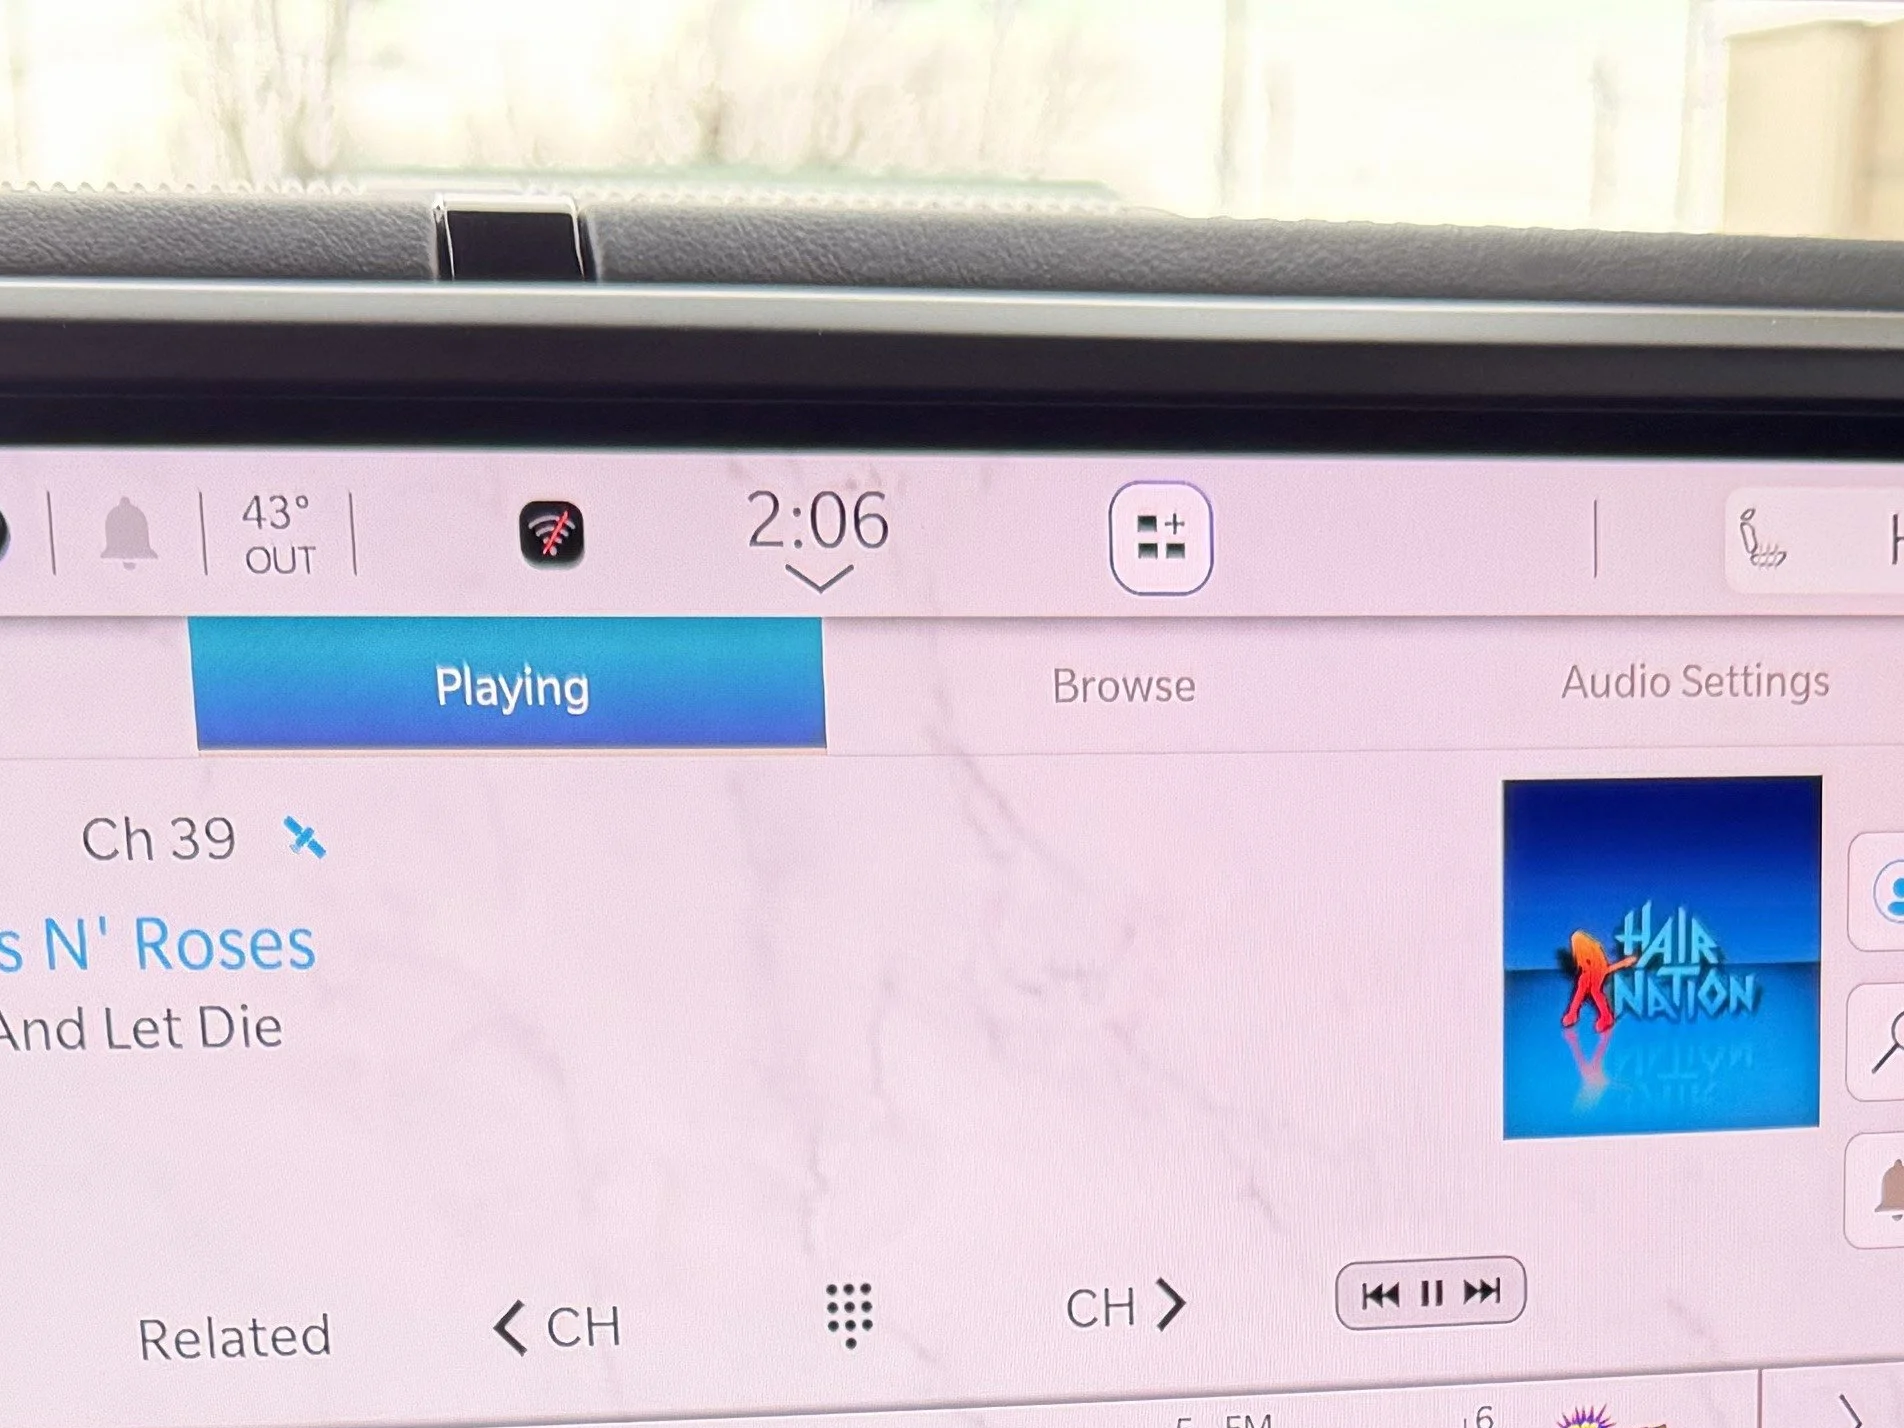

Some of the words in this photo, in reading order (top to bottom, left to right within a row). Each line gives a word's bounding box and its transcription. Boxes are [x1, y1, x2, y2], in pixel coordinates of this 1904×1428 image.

[241, 494, 310, 530] 43°
[747, 489, 889, 549] 2:06
[245, 545, 316, 576] OUT
[435, 664, 591, 715] Playing
[1053, 666, 1197, 705] Browse
[1562, 662, 1671, 702] Audio
[1681, 662, 1830, 706] Settings
[82, 817, 154, 862] Ch
[170, 817, 236, 862] 39
[44, 914, 109, 973] N'
[136, 914, 317, 972] Roses
[1613, 900, 1724, 969] HAIR
[1612, 966, 1763, 1023] NATION
[104, 1006, 183, 1051] Let
[198, 1004, 284, 1049] Die
[546, 1305, 621, 1348] CH
[1066, 1288, 1135, 1329] CH
[138, 1314, 333, 1364] Related
